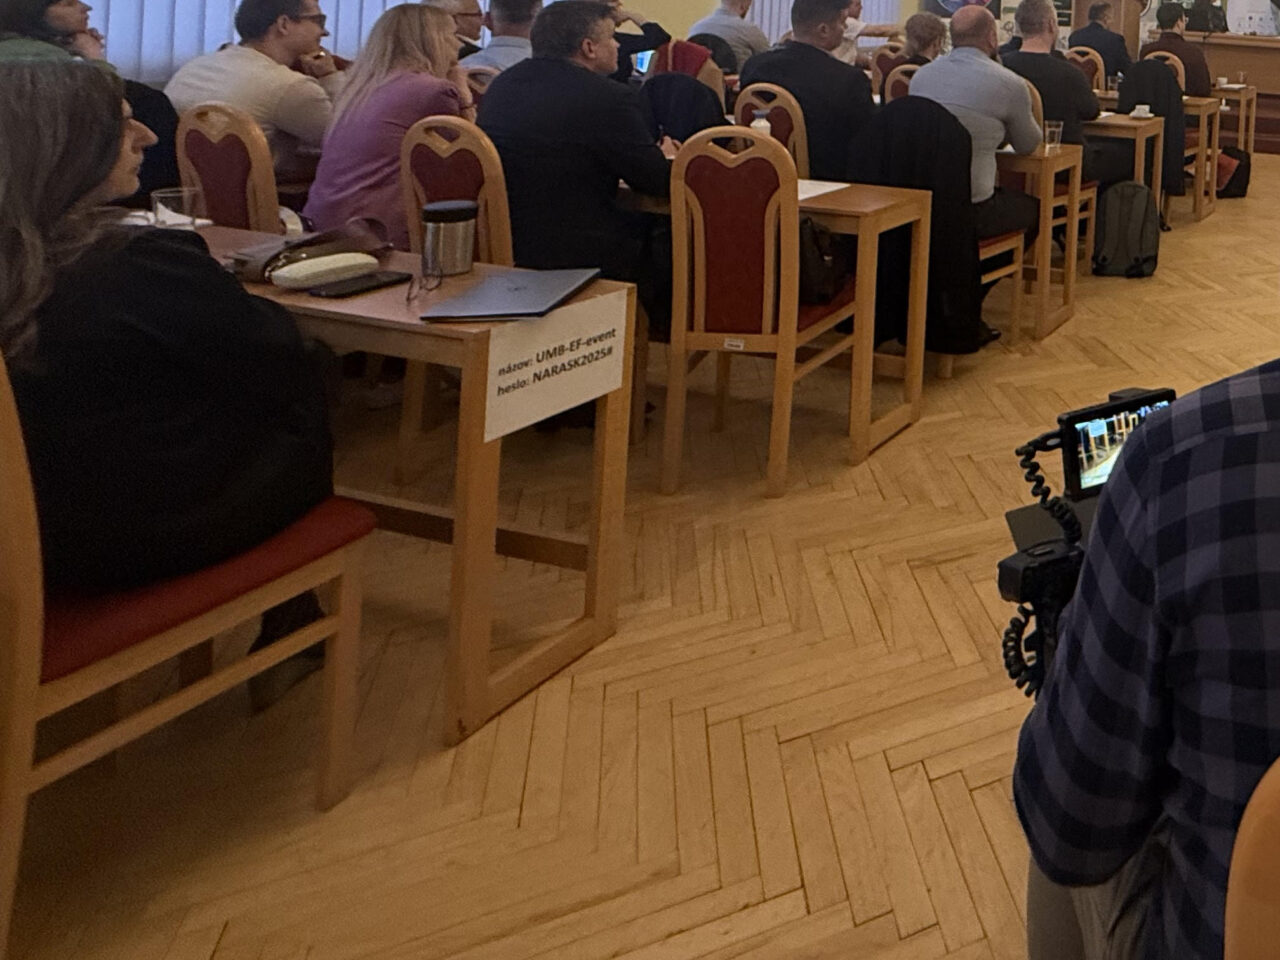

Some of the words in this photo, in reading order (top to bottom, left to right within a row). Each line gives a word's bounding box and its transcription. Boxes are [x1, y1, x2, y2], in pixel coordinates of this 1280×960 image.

[497, 380, 529, 396] heslo:
[532, 346, 613, 383] NARASK2025#
[498, 358, 532, 376] názov:
[536, 328, 617, 363] UMB-EF-event
